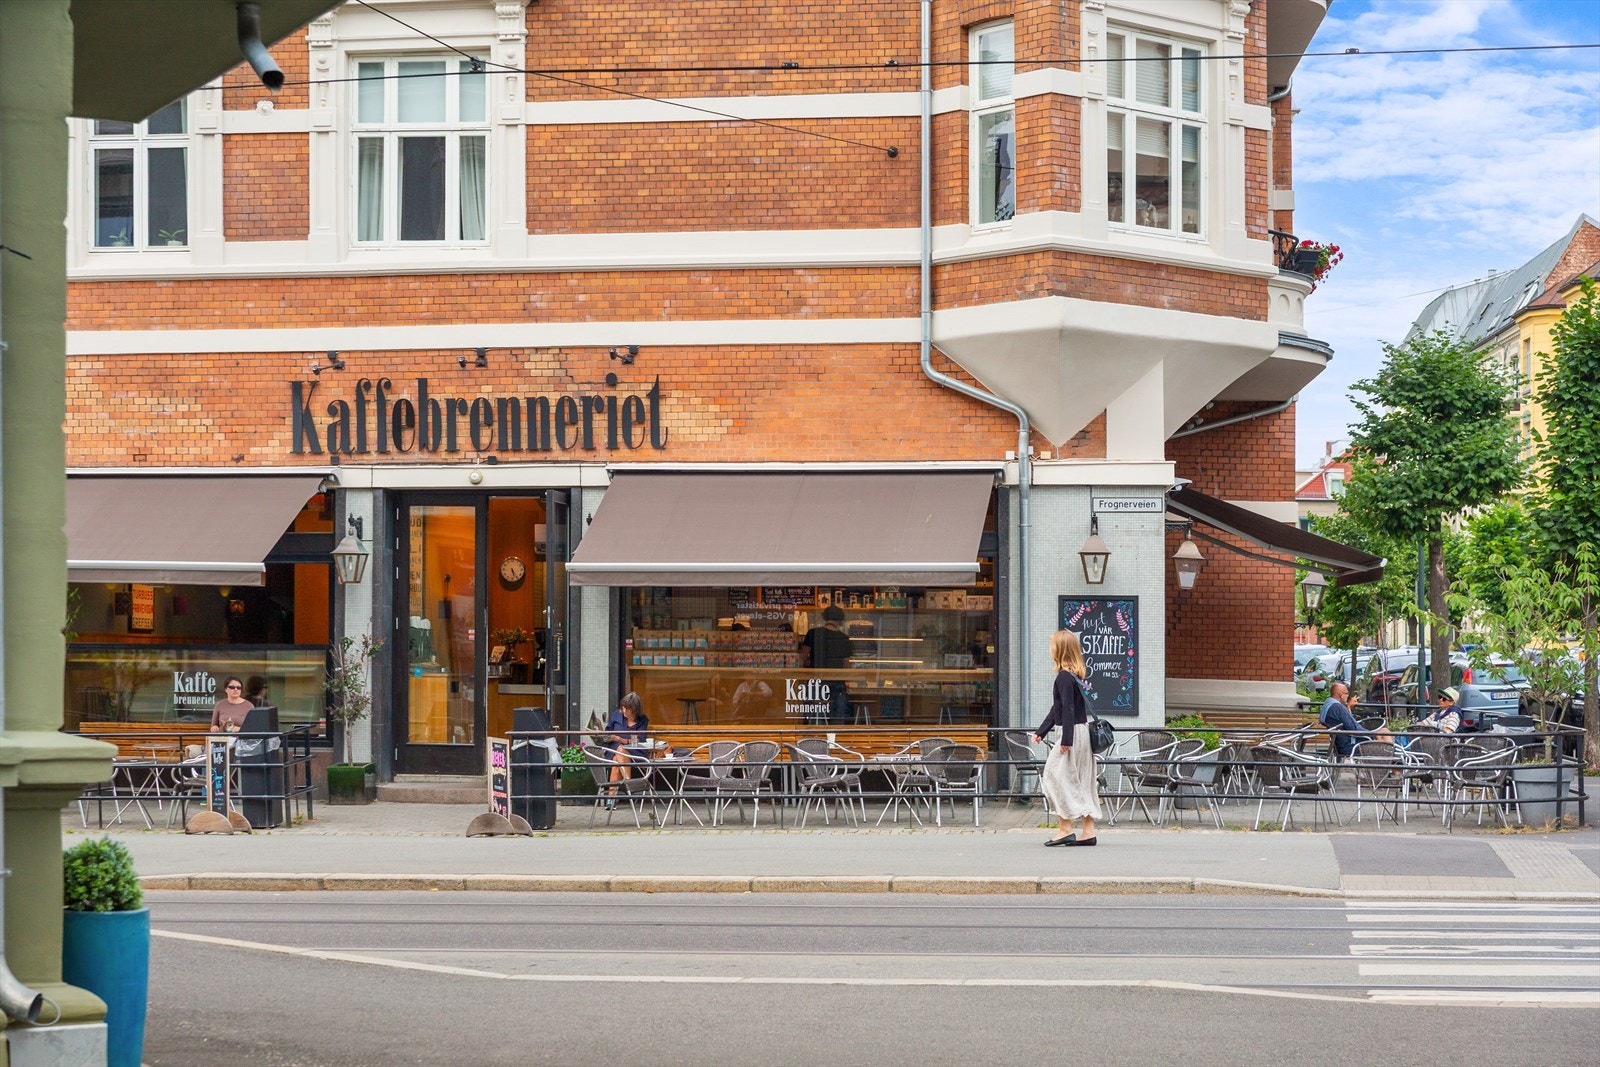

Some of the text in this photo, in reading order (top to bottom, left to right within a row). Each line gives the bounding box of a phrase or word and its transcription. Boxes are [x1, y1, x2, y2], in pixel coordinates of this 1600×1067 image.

[290, 373, 668, 454] Kaffebrenneriet
[1099, 500, 1156, 509] Frognerveien
[1085, 656, 1121, 679] Sommer
[173, 671, 217, 693] Kaffe
[785, 678, 830, 701] Kaffe
[173, 694, 216, 705] brenneriet
[785, 701, 830, 713] brenneriet
